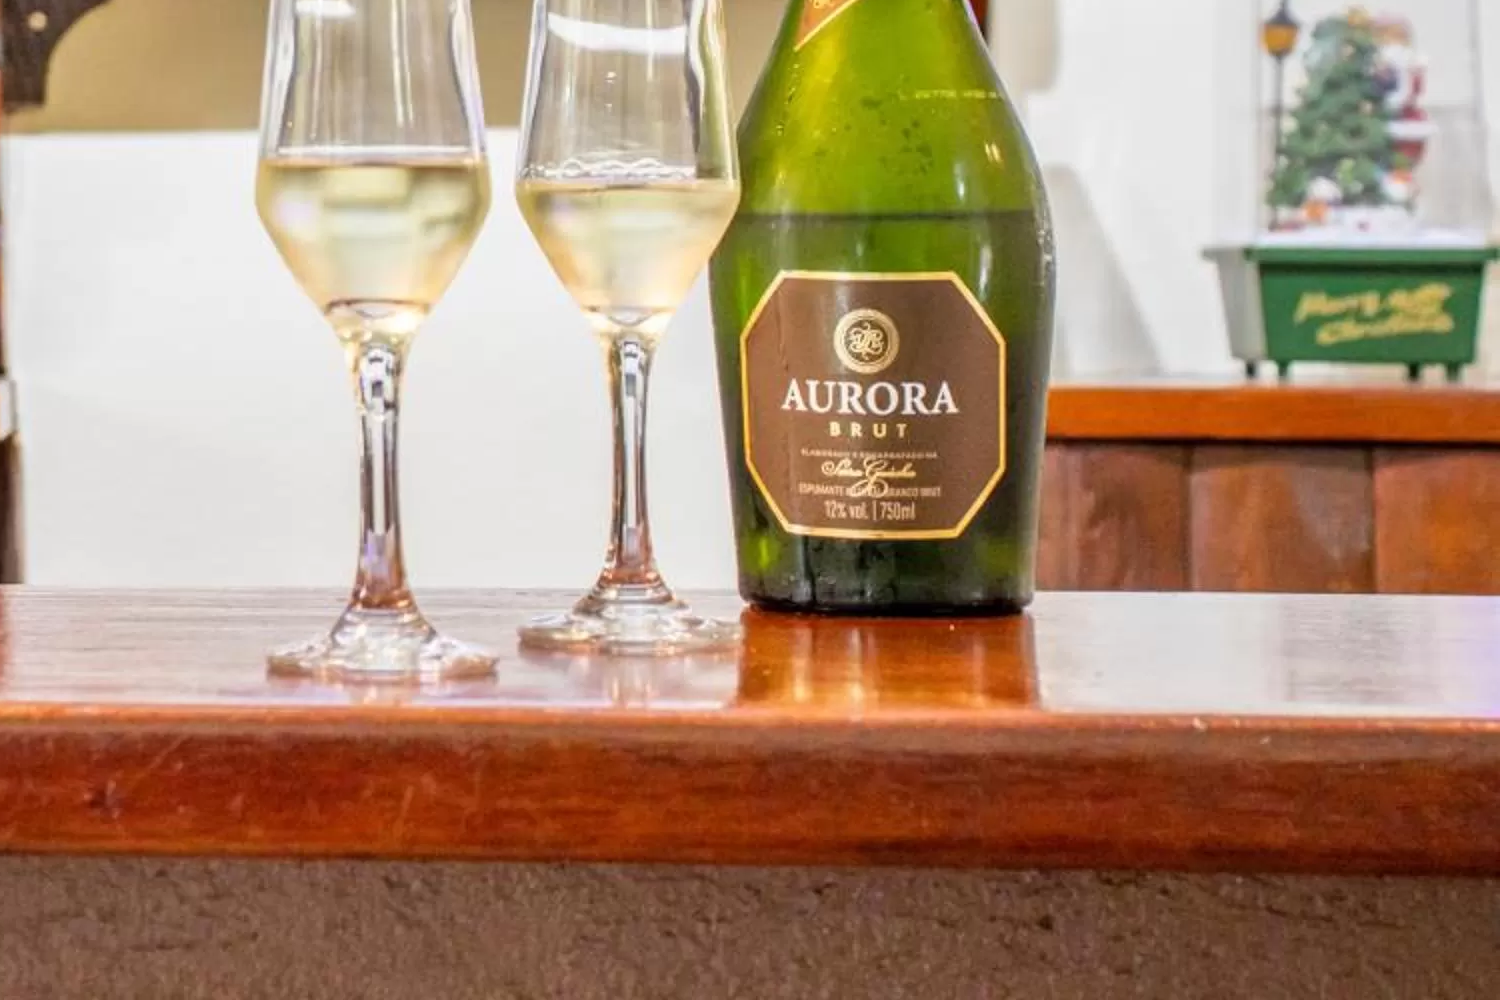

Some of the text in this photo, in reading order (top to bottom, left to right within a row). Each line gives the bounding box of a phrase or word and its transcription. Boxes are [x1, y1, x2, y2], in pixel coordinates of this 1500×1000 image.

[781, 378, 960, 416] AURORA
[829, 421, 909, 438] BRUT
[824, 500, 846, 519] 12%
[880, 501, 916, 521] 750ml
